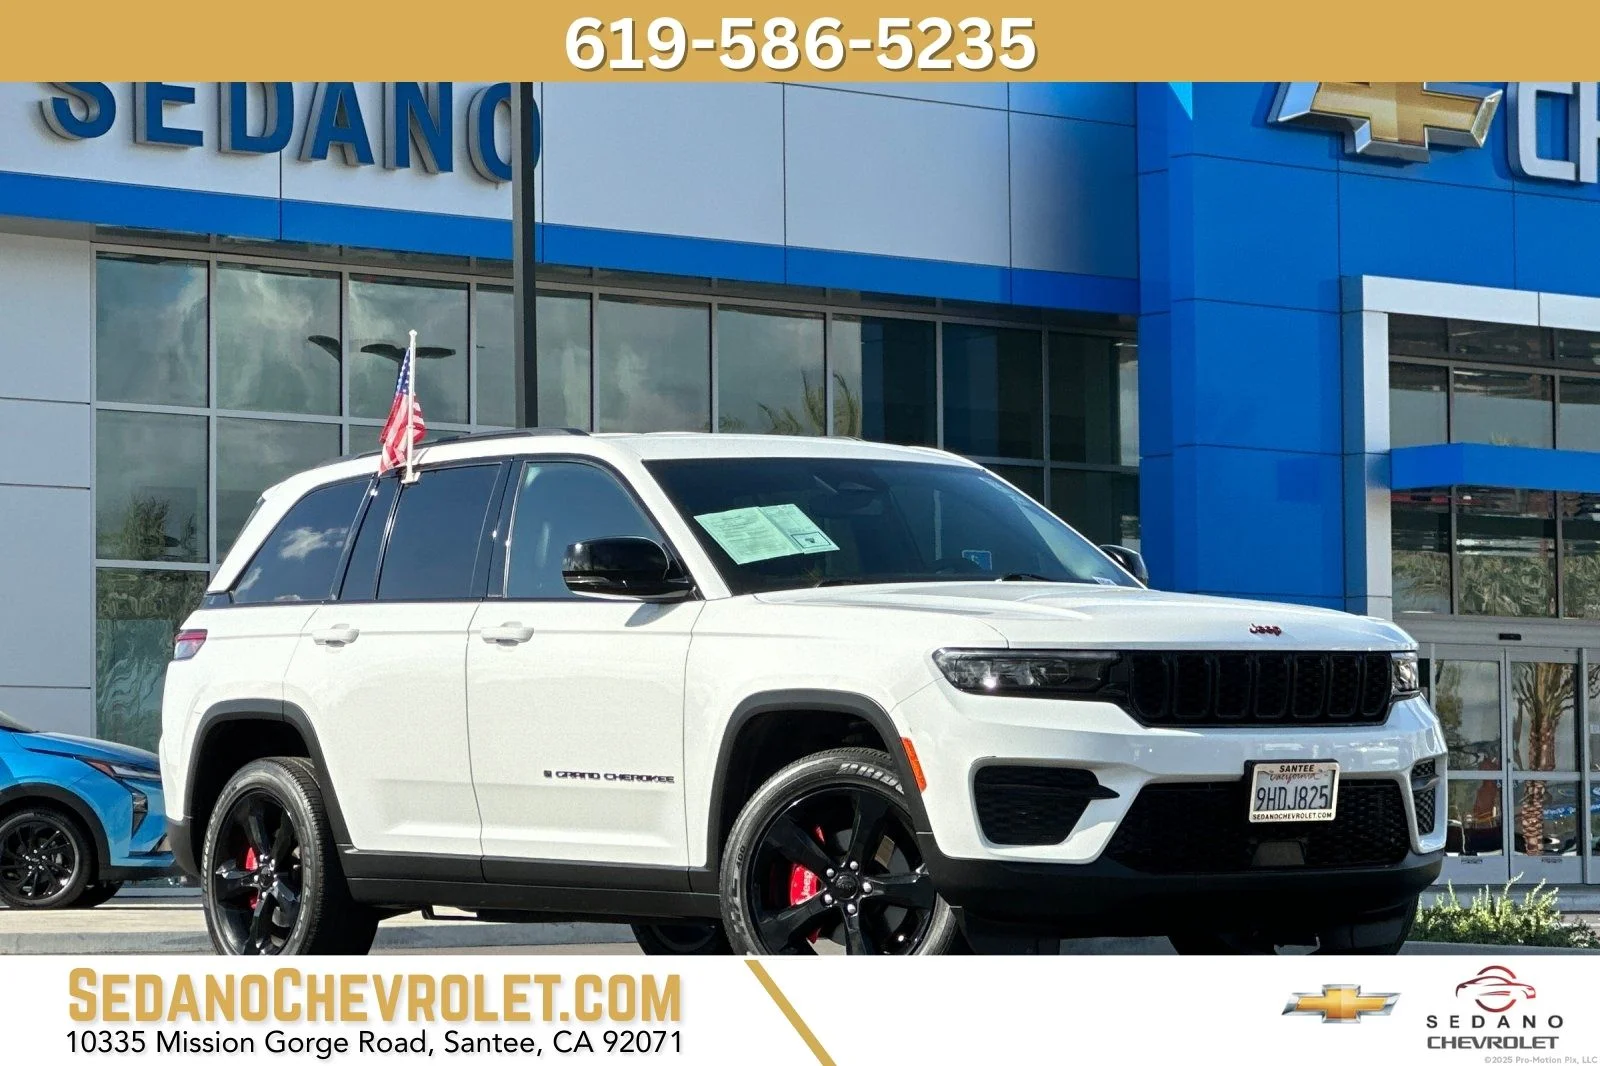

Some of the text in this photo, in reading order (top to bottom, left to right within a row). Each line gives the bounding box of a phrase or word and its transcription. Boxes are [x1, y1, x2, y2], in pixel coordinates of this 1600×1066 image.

[42, 82, 541, 184] SEDANO
[1279, 764, 1315, 773] SANTEE
[555, 771, 675, 784] GRAND CHEROKEE
[1256, 785, 1328, 811] 9HDJ825
[1252, 812, 1332, 820] SEDANOCHEVROLET.COM
